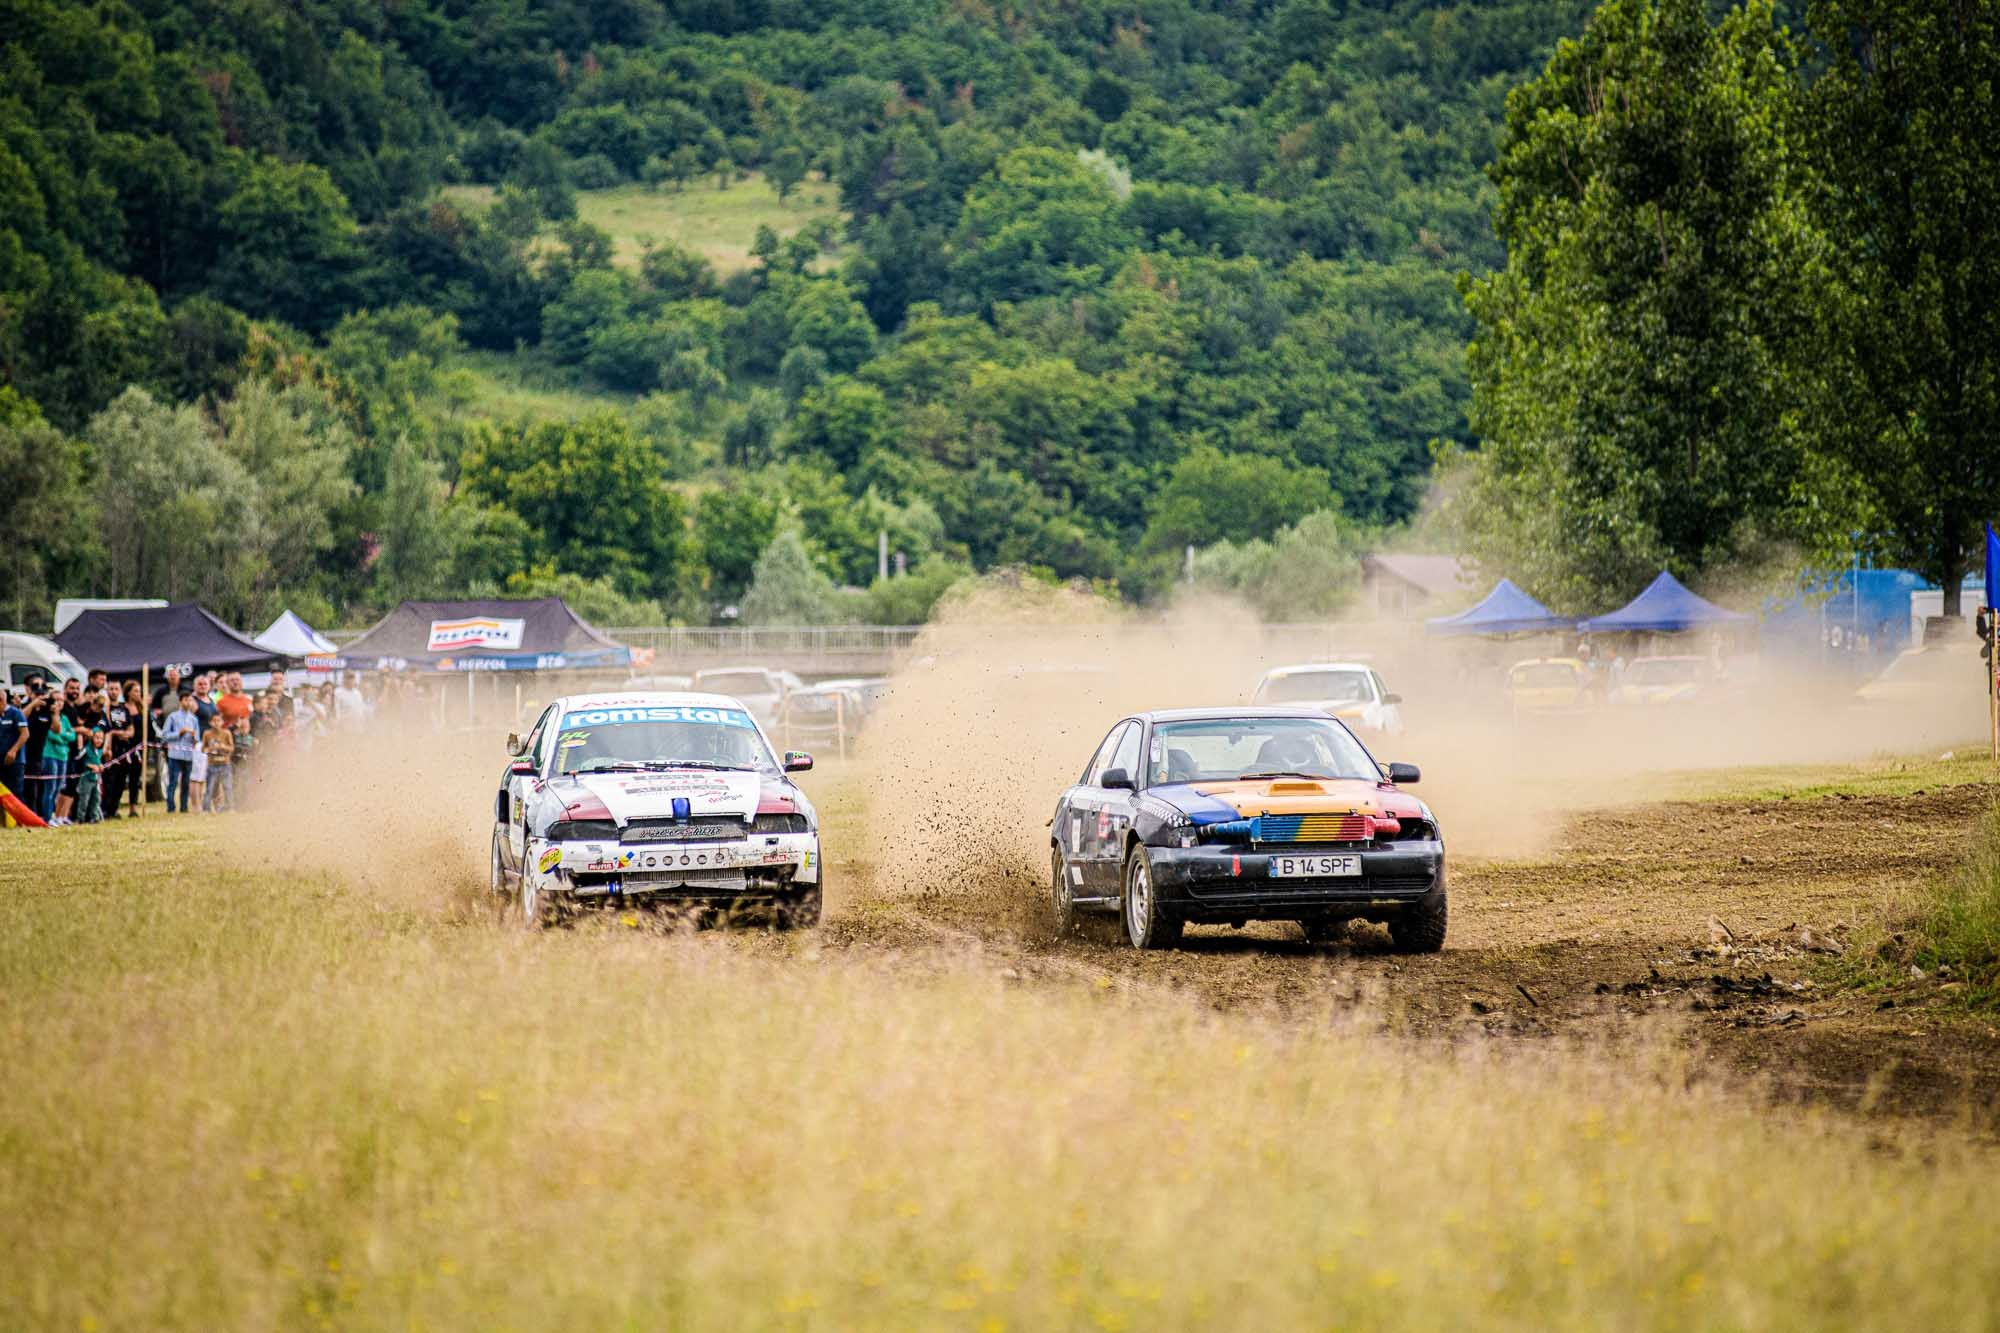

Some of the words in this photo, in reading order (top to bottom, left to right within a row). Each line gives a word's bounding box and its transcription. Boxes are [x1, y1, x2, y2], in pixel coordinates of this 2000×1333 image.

[1282, 859, 1295, 875] B
[1300, 859, 1315, 875] 14
[1320, 858, 1354, 874] SPF
